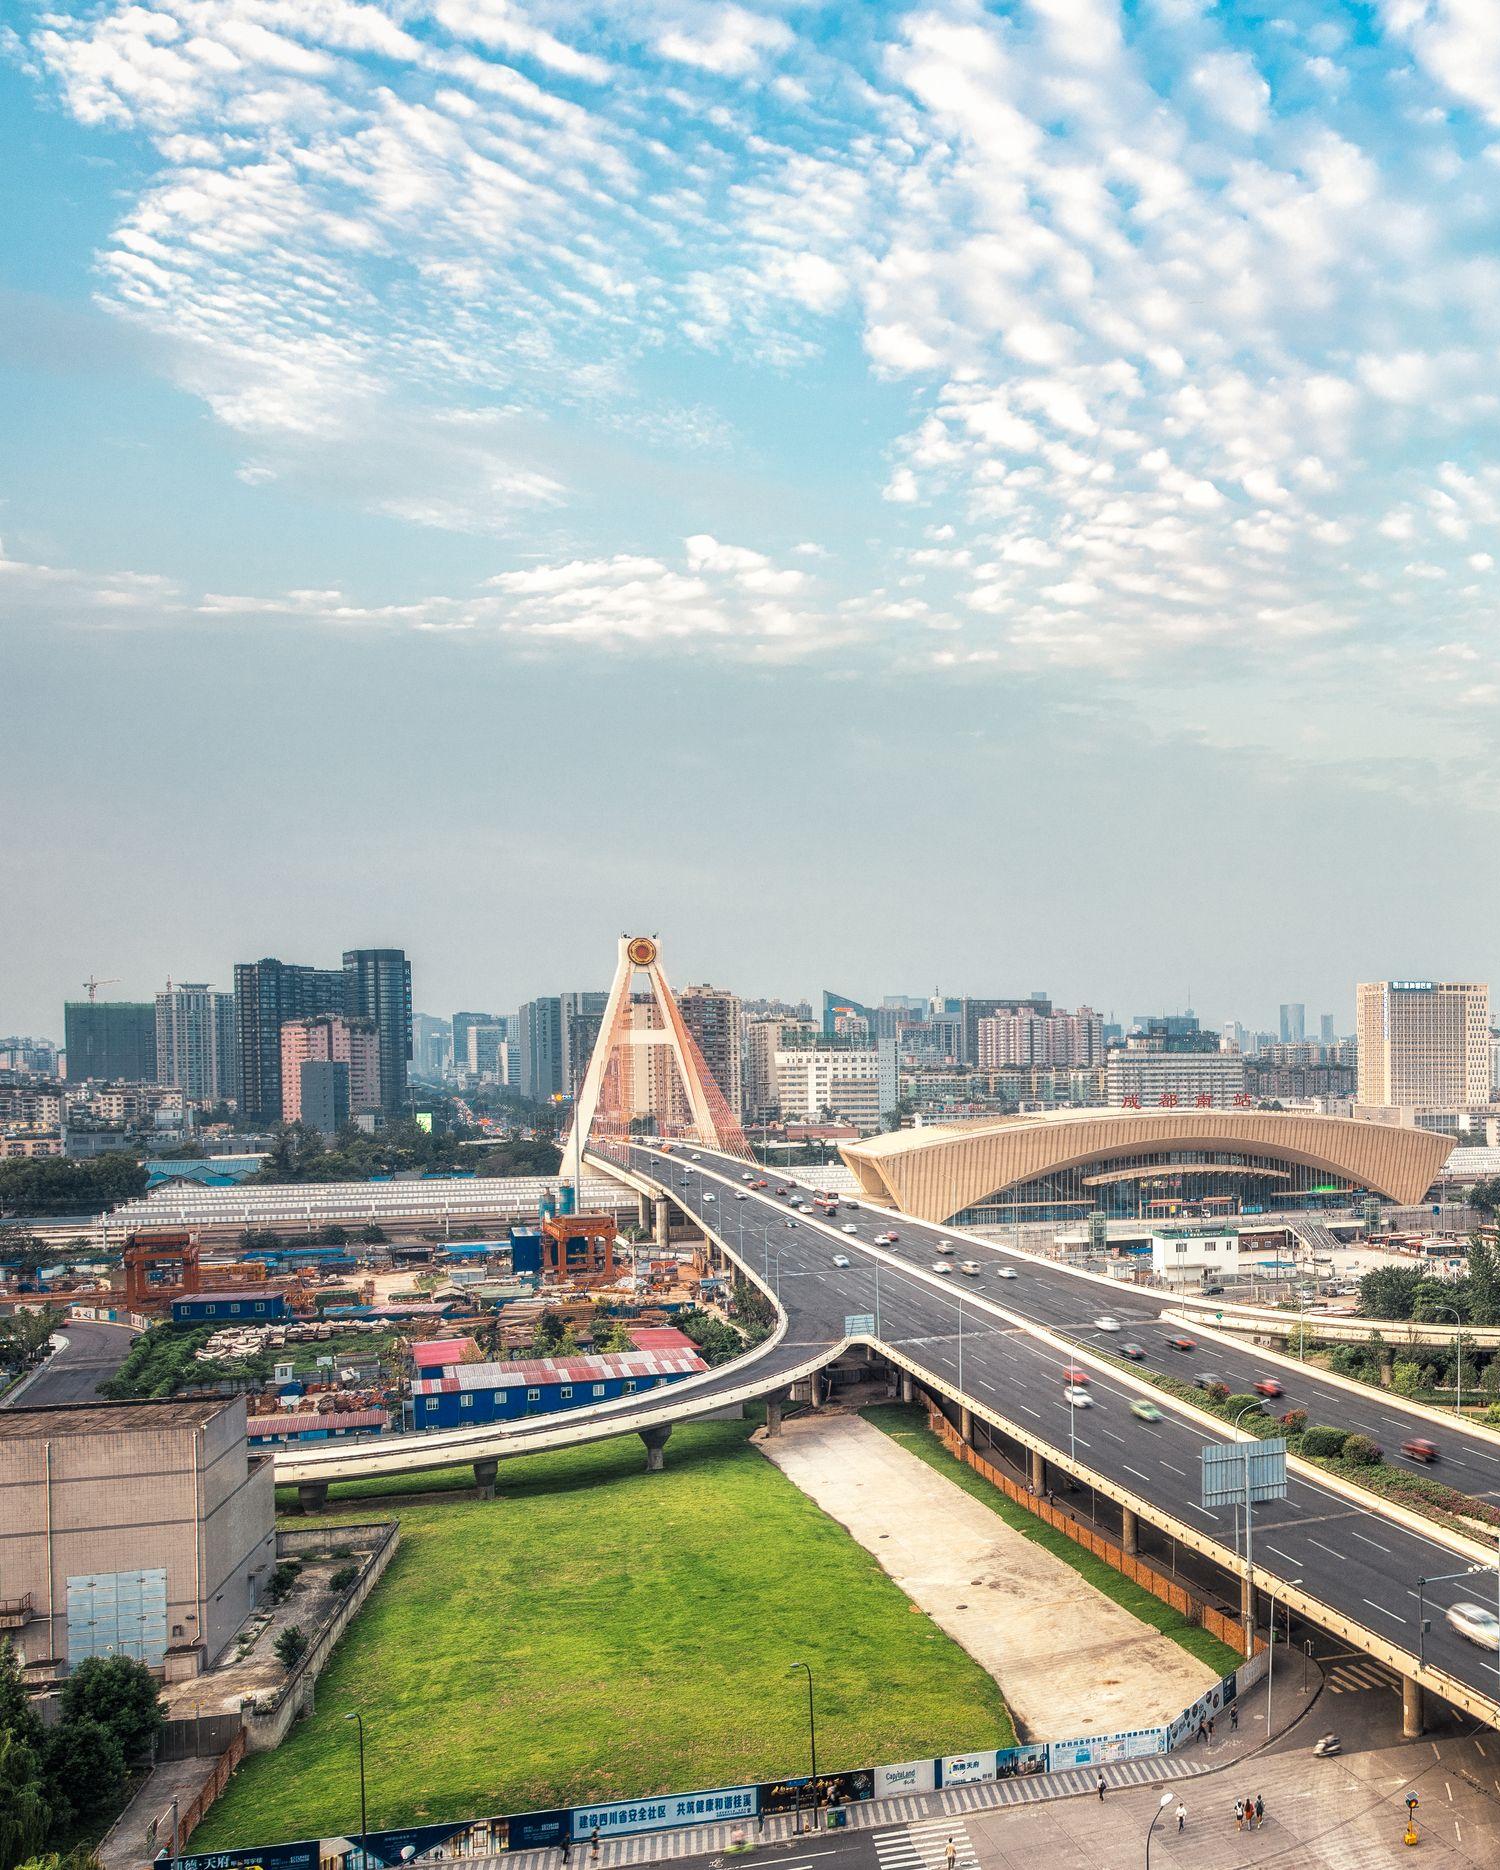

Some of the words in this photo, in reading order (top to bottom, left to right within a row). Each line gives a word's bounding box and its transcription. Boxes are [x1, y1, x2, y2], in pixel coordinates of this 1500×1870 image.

[1121, 1092, 1253, 1110] 成都南站
[579, 1804, 667, 1830] 建设四川省安全社区
[676, 1793, 752, 1817] 共筑健康和谐桂溪
